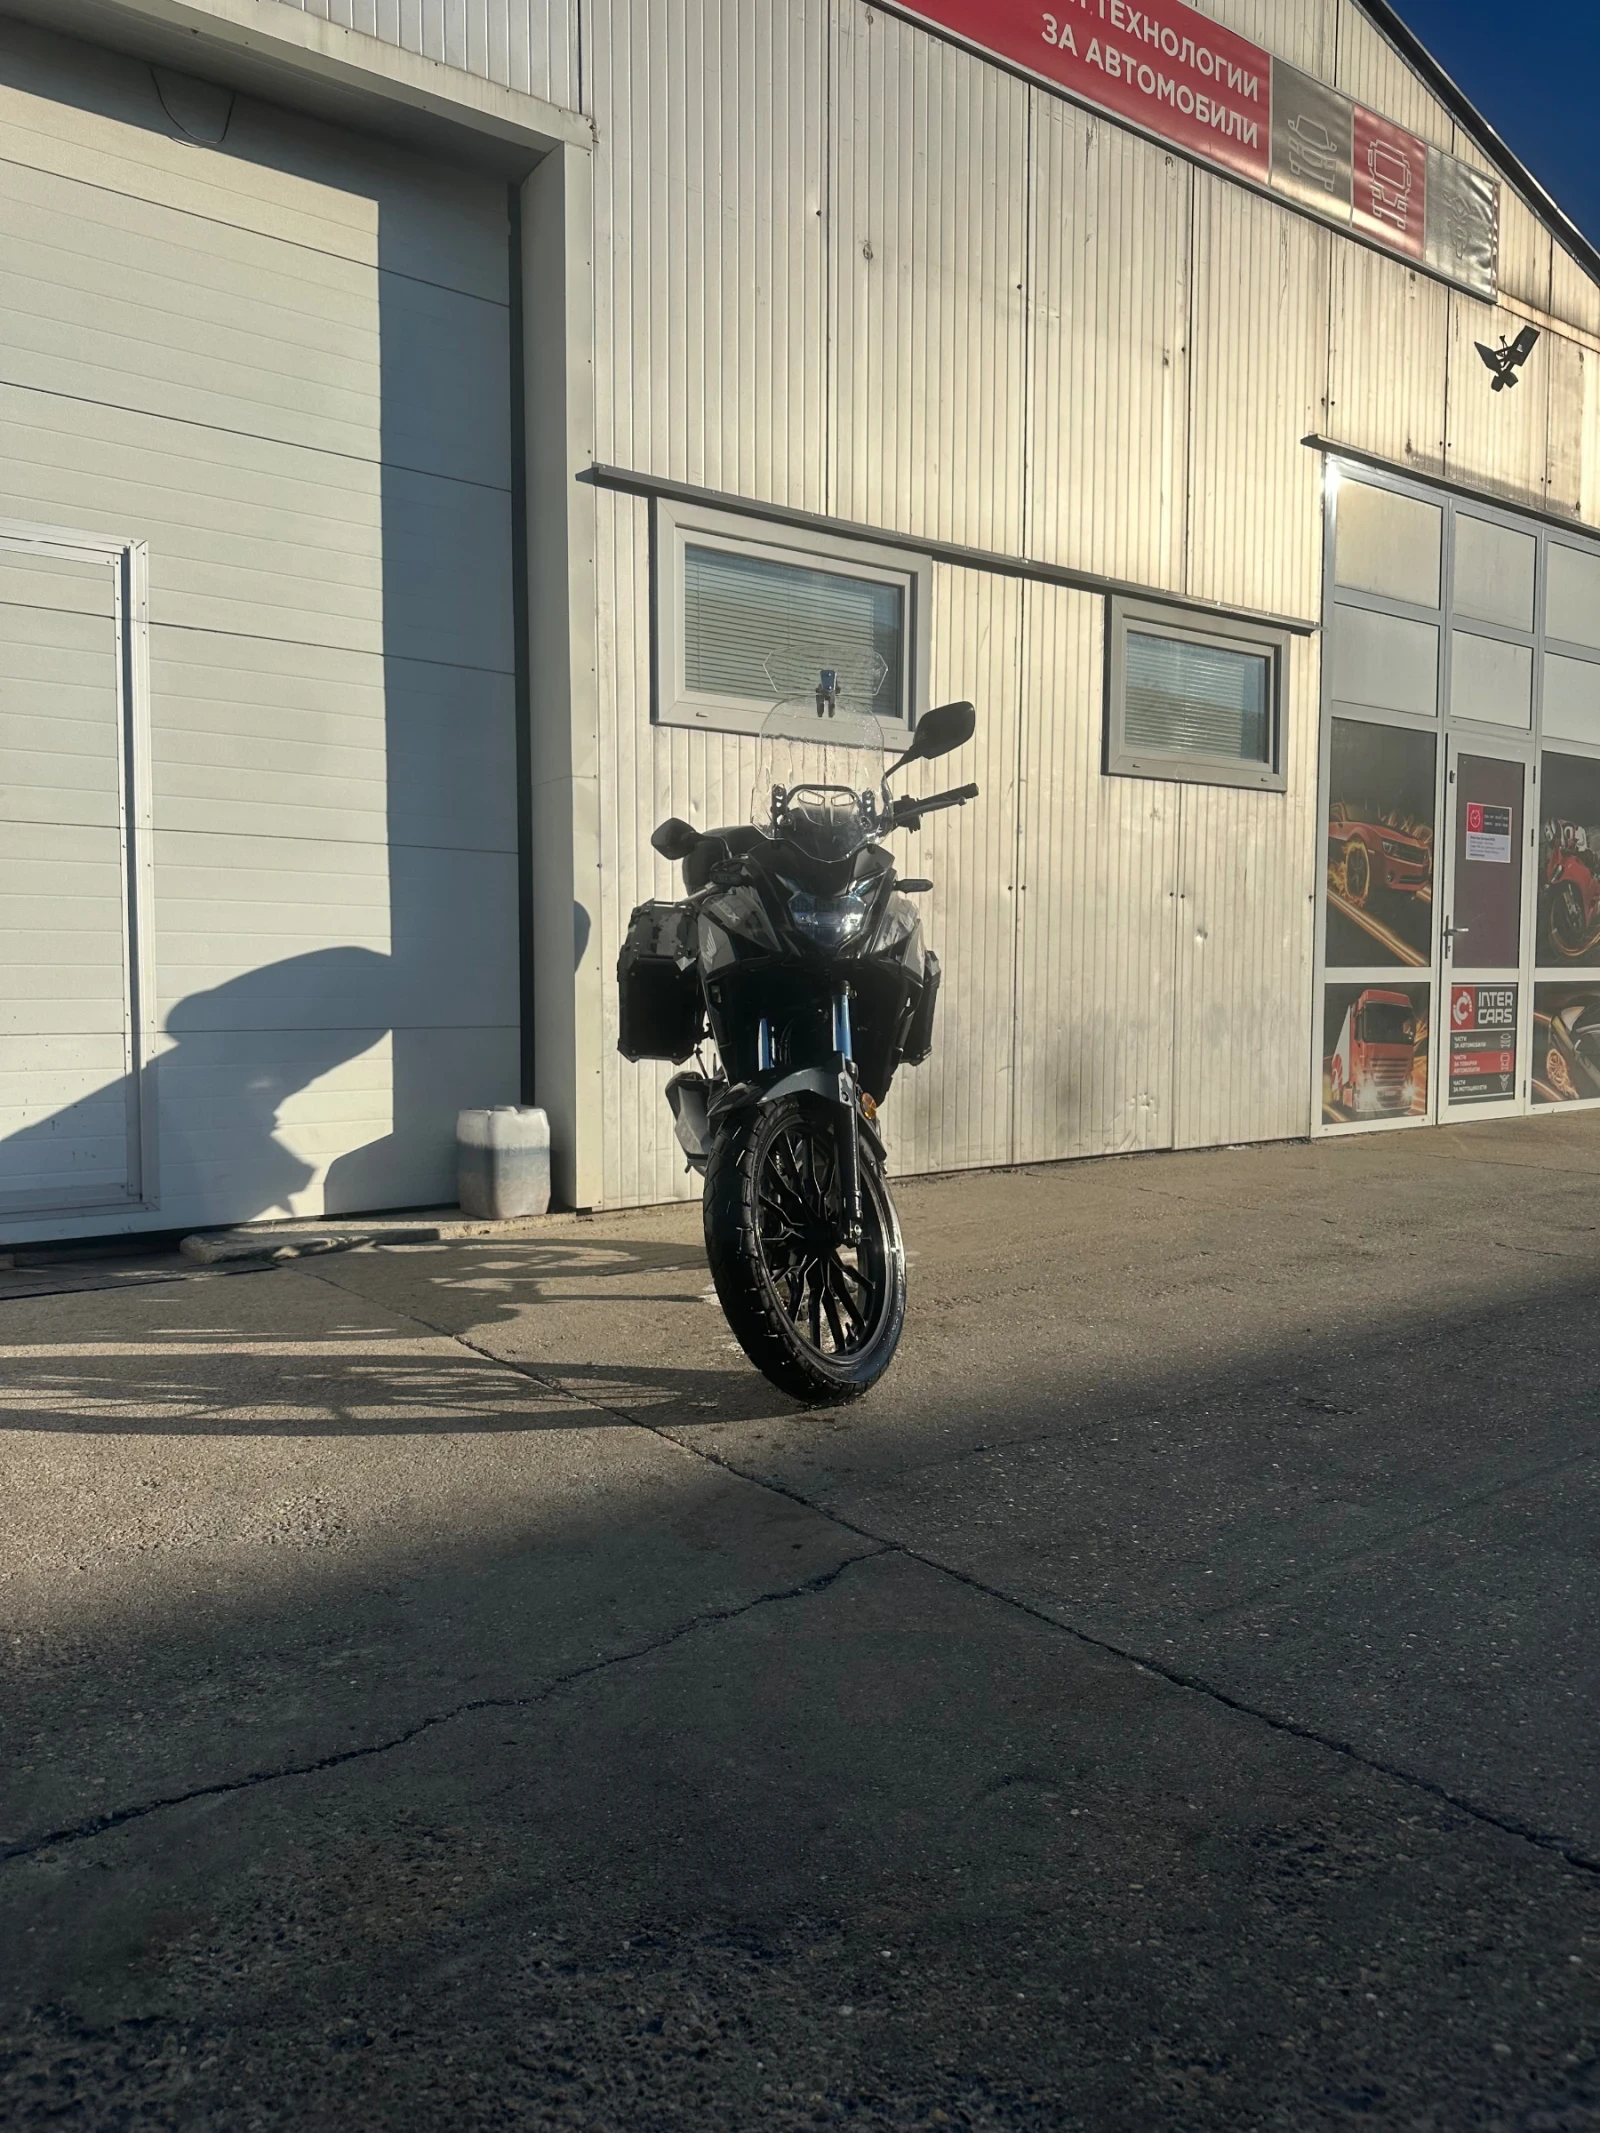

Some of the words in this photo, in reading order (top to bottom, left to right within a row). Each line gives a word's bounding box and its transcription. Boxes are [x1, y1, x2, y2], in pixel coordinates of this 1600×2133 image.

[1099, 0, 1258, 102] ТЕХНОЛОГИИ
[1041, 13, 1078, 57] ЗА
[1085, 37, 1258, 149] АВТОМОБИЛИ
[1478, 991, 1514, 1007] INTER
[1478, 1008, 1513, 1024] CARS
